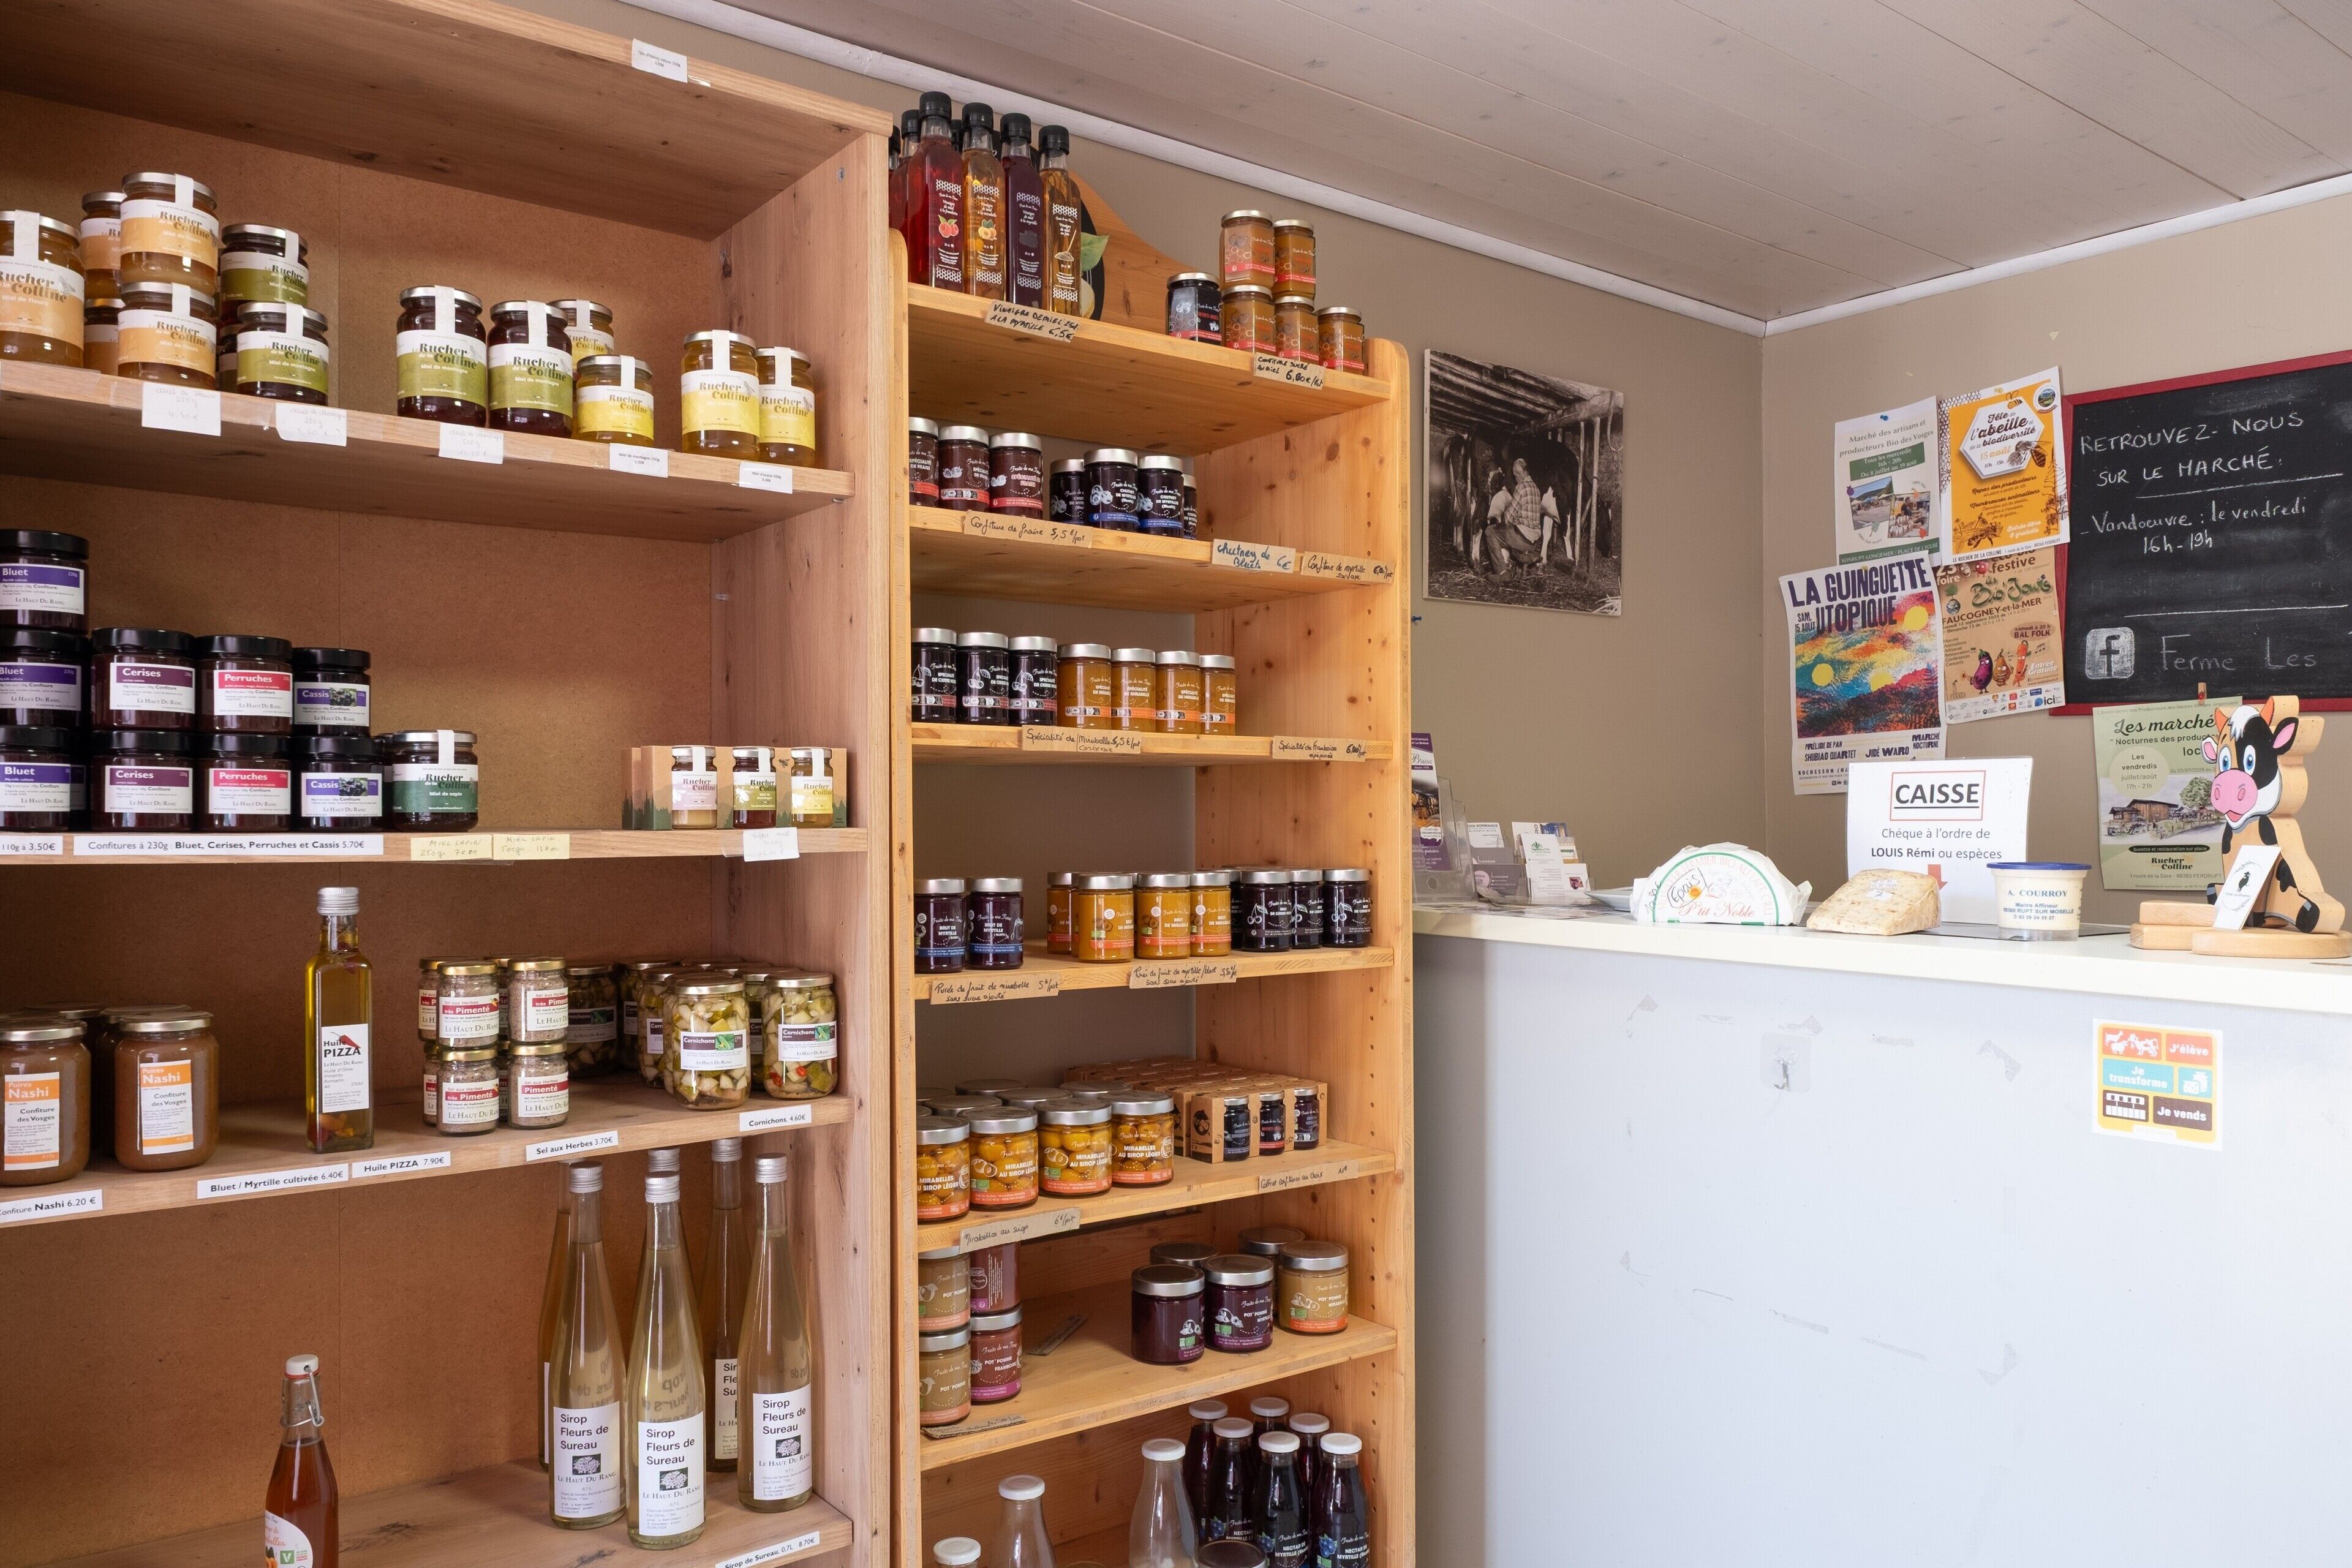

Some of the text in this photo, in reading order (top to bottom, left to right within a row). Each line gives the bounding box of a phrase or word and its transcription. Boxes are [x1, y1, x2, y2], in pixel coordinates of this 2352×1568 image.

[420, 343, 467, 357] Rucher
[433, 355, 477, 369] Colline
[699, 382, 741, 391] Rucher
[712, 390, 750, 403] Colline
[1988, 412, 2008, 423] Fête
[1970, 417, 2028, 440] l'abeille
[2233, 412, 2304, 435] NOUS
[1849, 432, 1877, 443] Marché
[1893, 424, 1918, 434] artisans
[1983, 426, 2036, 447] biodiversité
[1839, 442, 1885, 458] producteurs
[1913, 431, 1934, 440] Vosges
[2097, 470, 2128, 486] SUR
[2144, 467, 2163, 480] LE
[2212, 500, 2225, 521] le
[2233, 497, 2306, 518] vendredi
[1019, 524, 1044, 538] fraise
[1261, 546, 1270, 560] de
[1992, 556, 2035, 573] festive
[1788, 558, 1931, 608] LA GUINGUETTE
[1936, 575, 1960, 586] foire
[1797, 612, 1812, 622] SAM.
[1815, 597, 1897, 634] UTOPIQUE
[1795, 624, 1801, 633] 15
[2161, 633, 2317, 671] Ferme Les
[2030, 660, 2054, 669] Entrée
[123, 668, 161, 678] Cerises
[2029, 665, 2057, 676] Gratuite
[224, 674, 273, 683] Perruches
[2044, 696, 2056, 705] ici
[2114, 714, 2215, 736] Les marché
[1912, 731, 1940, 741] MARCHÉ
[1913, 741, 1939, 749] NOCTURNE
[1804, 750, 1856, 761] SHUBIAO QUARTET
[1866, 747, 1909, 758] JIDÉ WARO
[116, 771, 154, 779] Cerises
[2121, 773, 2157, 782] juillet/août
[1896, 783, 1980, 804] CAISSE
[1882, 828, 1990, 841] Chéque à l'ordre de
[29, 842, 56, 851] 3.50€
[148, 842, 168, 851] 230g
[175, 842, 204, 850] Bluet,
[208, 842, 245, 850] Cerises,
[249, 841, 296, 850] Perruches
[1871, 848, 1903, 857] LOUIS
[1907, 846, 1934, 858] Rémi
[1956, 848, 2002, 861] espèces
[1714, 900, 1755, 918] Noble
[324, 1047, 361, 1058] PIZZA
[2169, 1043, 2209, 1057] J'élève
[2132, 1066, 2144, 1076] Je
[143, 1072, 181, 1084] Nashi
[2109, 1074, 2168, 1088] transforme
[9, 1087, 49, 1098] Nashi
[524, 1085, 558, 1093] Pimenté
[2157, 1106, 2207, 1121] Je vends
[565, 1141, 593, 1151] Herbes
[594, 1137, 613, 1146] 3.70€
[1076, 1152, 1105, 1161] MIRABELLES
[1096, 1157, 1108, 1166] LÉGER
[364, 1164, 387, 1172] Huile
[390, 1161, 418, 1169] PIZZA
[210, 1171, 343, 1193] Bluet Myrtille cultivée 6.40€
[35, 1201, 64, 1210] Nashi
[67, 1198, 86, 1207] 6.20
[560, 1414, 587, 1425] Sirop
[560, 1425, 609, 1437] Fleurs de
[647, 1428, 675, 1439] Sirop
[560, 1441, 597, 1450] Sureau
[647, 1438, 695, 1452] Fleurs de
[647, 1455, 685, 1465] Sureau
[799, 1537, 815, 1547] 8.70€
[1283, 1543, 1300, 1551] NECTAR
